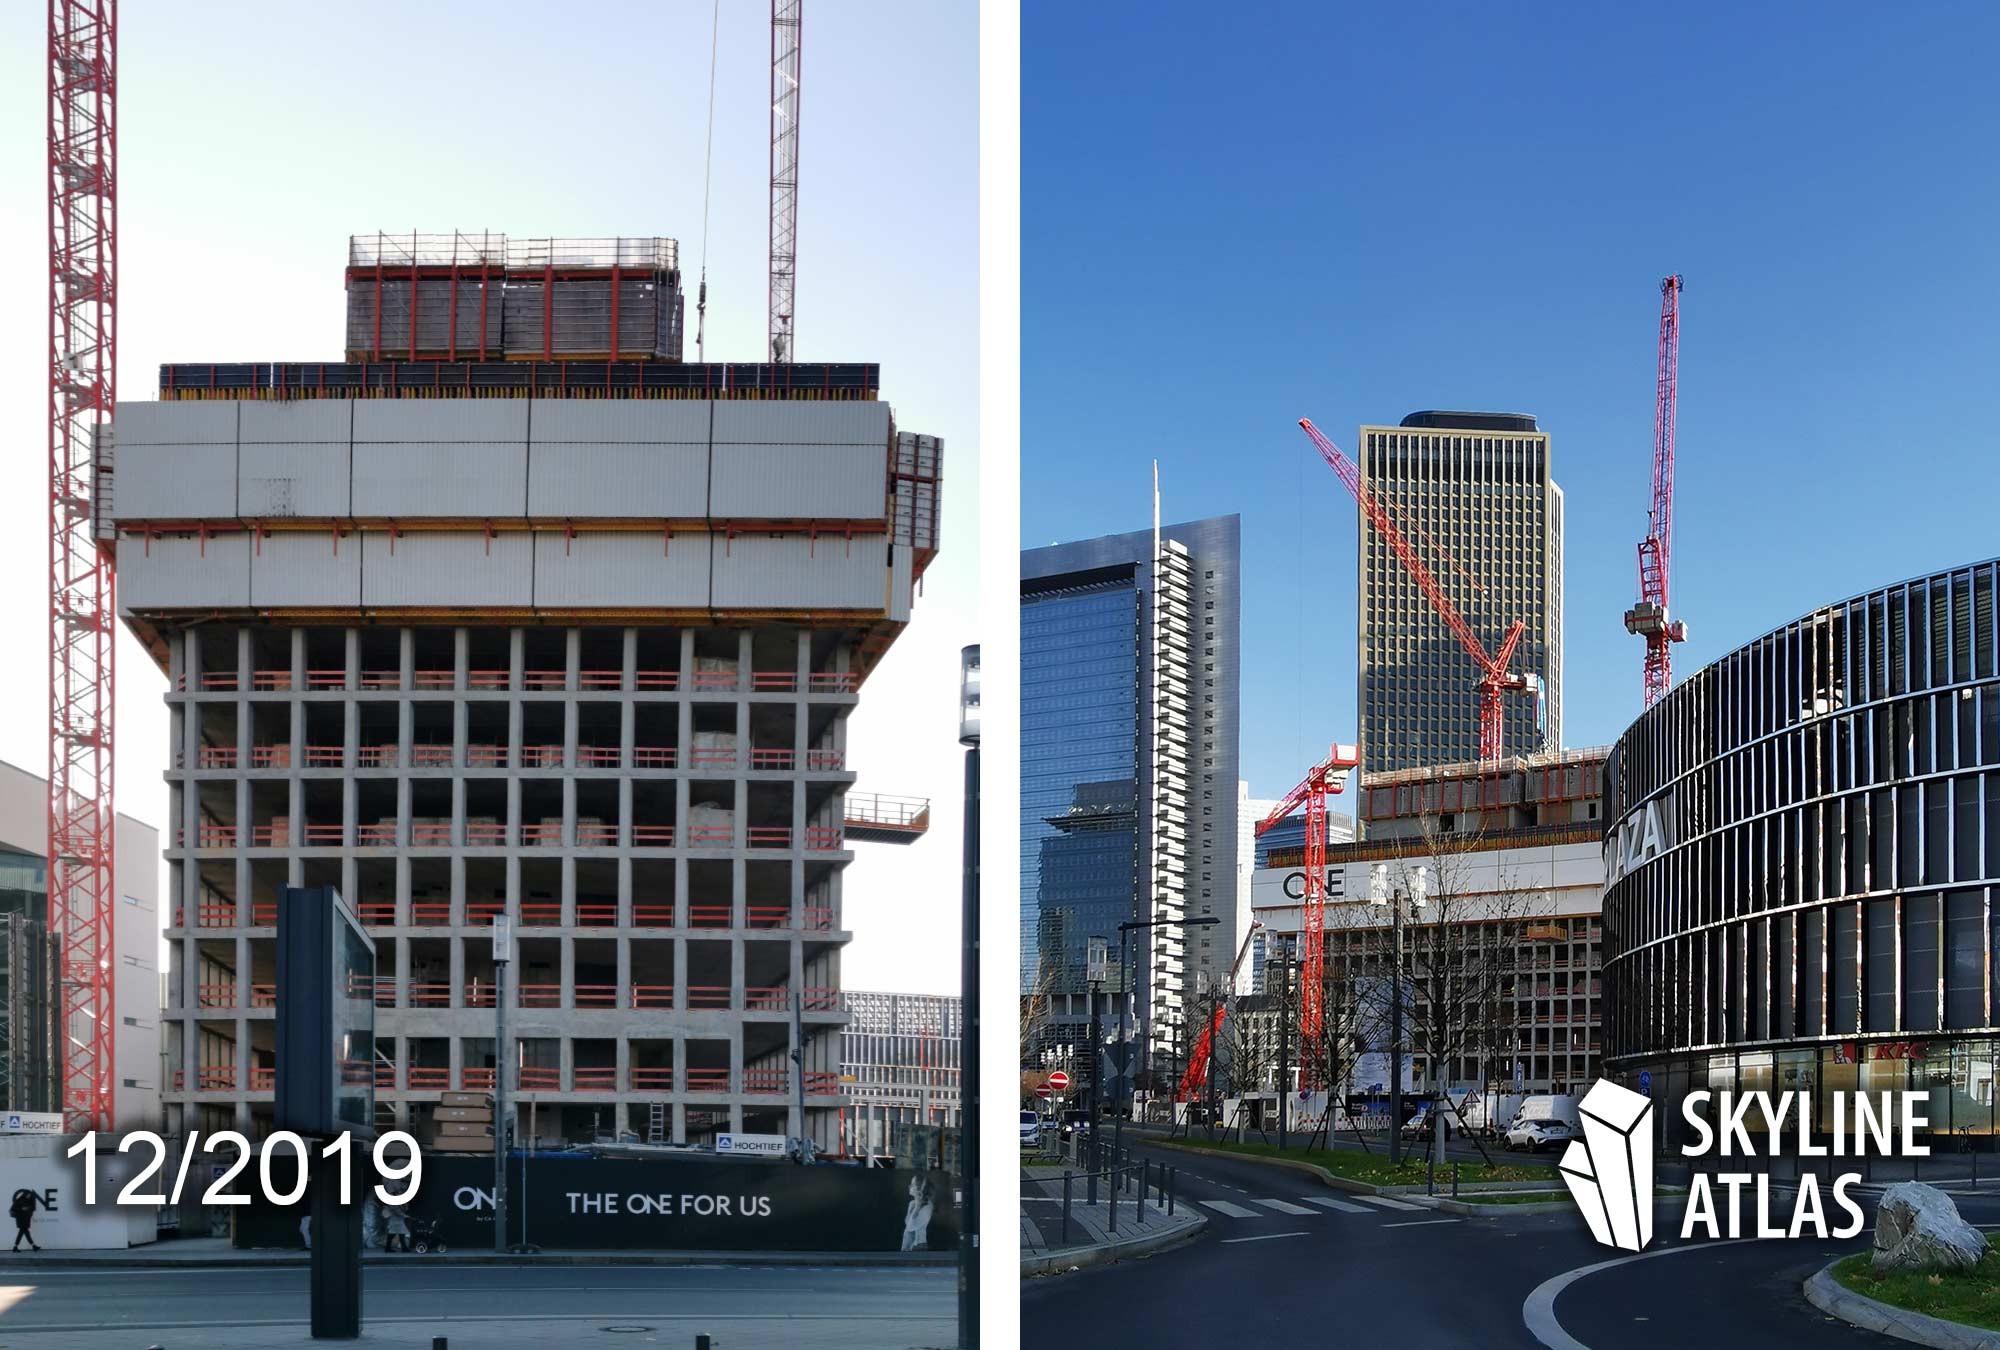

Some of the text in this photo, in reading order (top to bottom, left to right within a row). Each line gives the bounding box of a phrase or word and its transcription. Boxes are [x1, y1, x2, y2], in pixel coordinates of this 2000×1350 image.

[1875, 1043, 1928, 1060] KFC
[22, 1120, 61, 1130] HOCHTIEF
[734, 1141, 783, 1151] HOCHTIEF
[454, 1186, 506, 1211] ON
[566, 1192, 772, 1217] THE ONE FOR US
